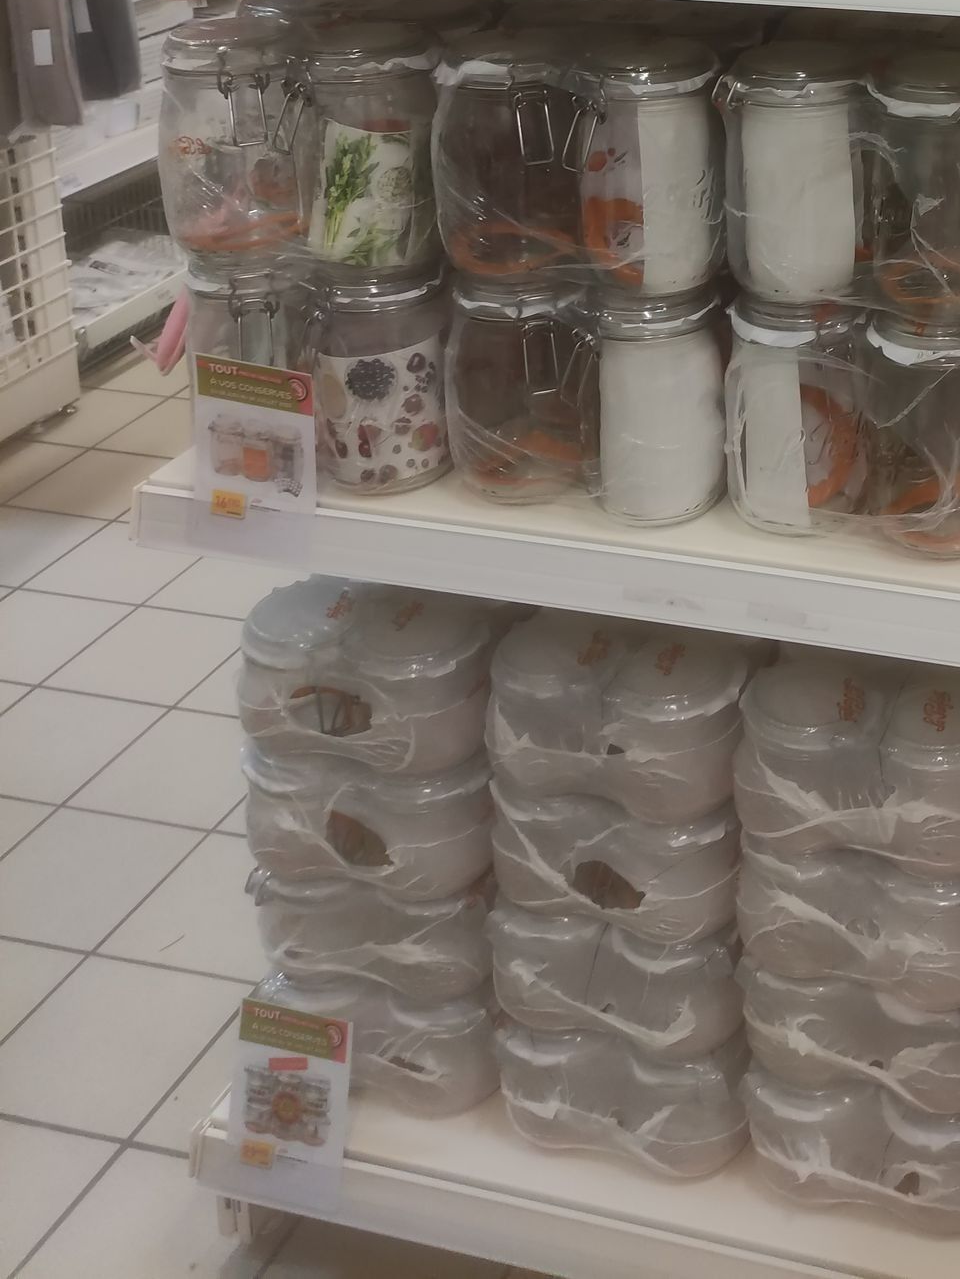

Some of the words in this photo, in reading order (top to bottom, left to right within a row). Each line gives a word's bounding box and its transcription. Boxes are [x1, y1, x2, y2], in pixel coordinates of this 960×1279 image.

[208, 363, 239, 375] TOUT
[219, 380, 237, 390] VOS
[238, 383, 292, 400] CONSERVES
[255, 1007, 281, 1019] TOUT
